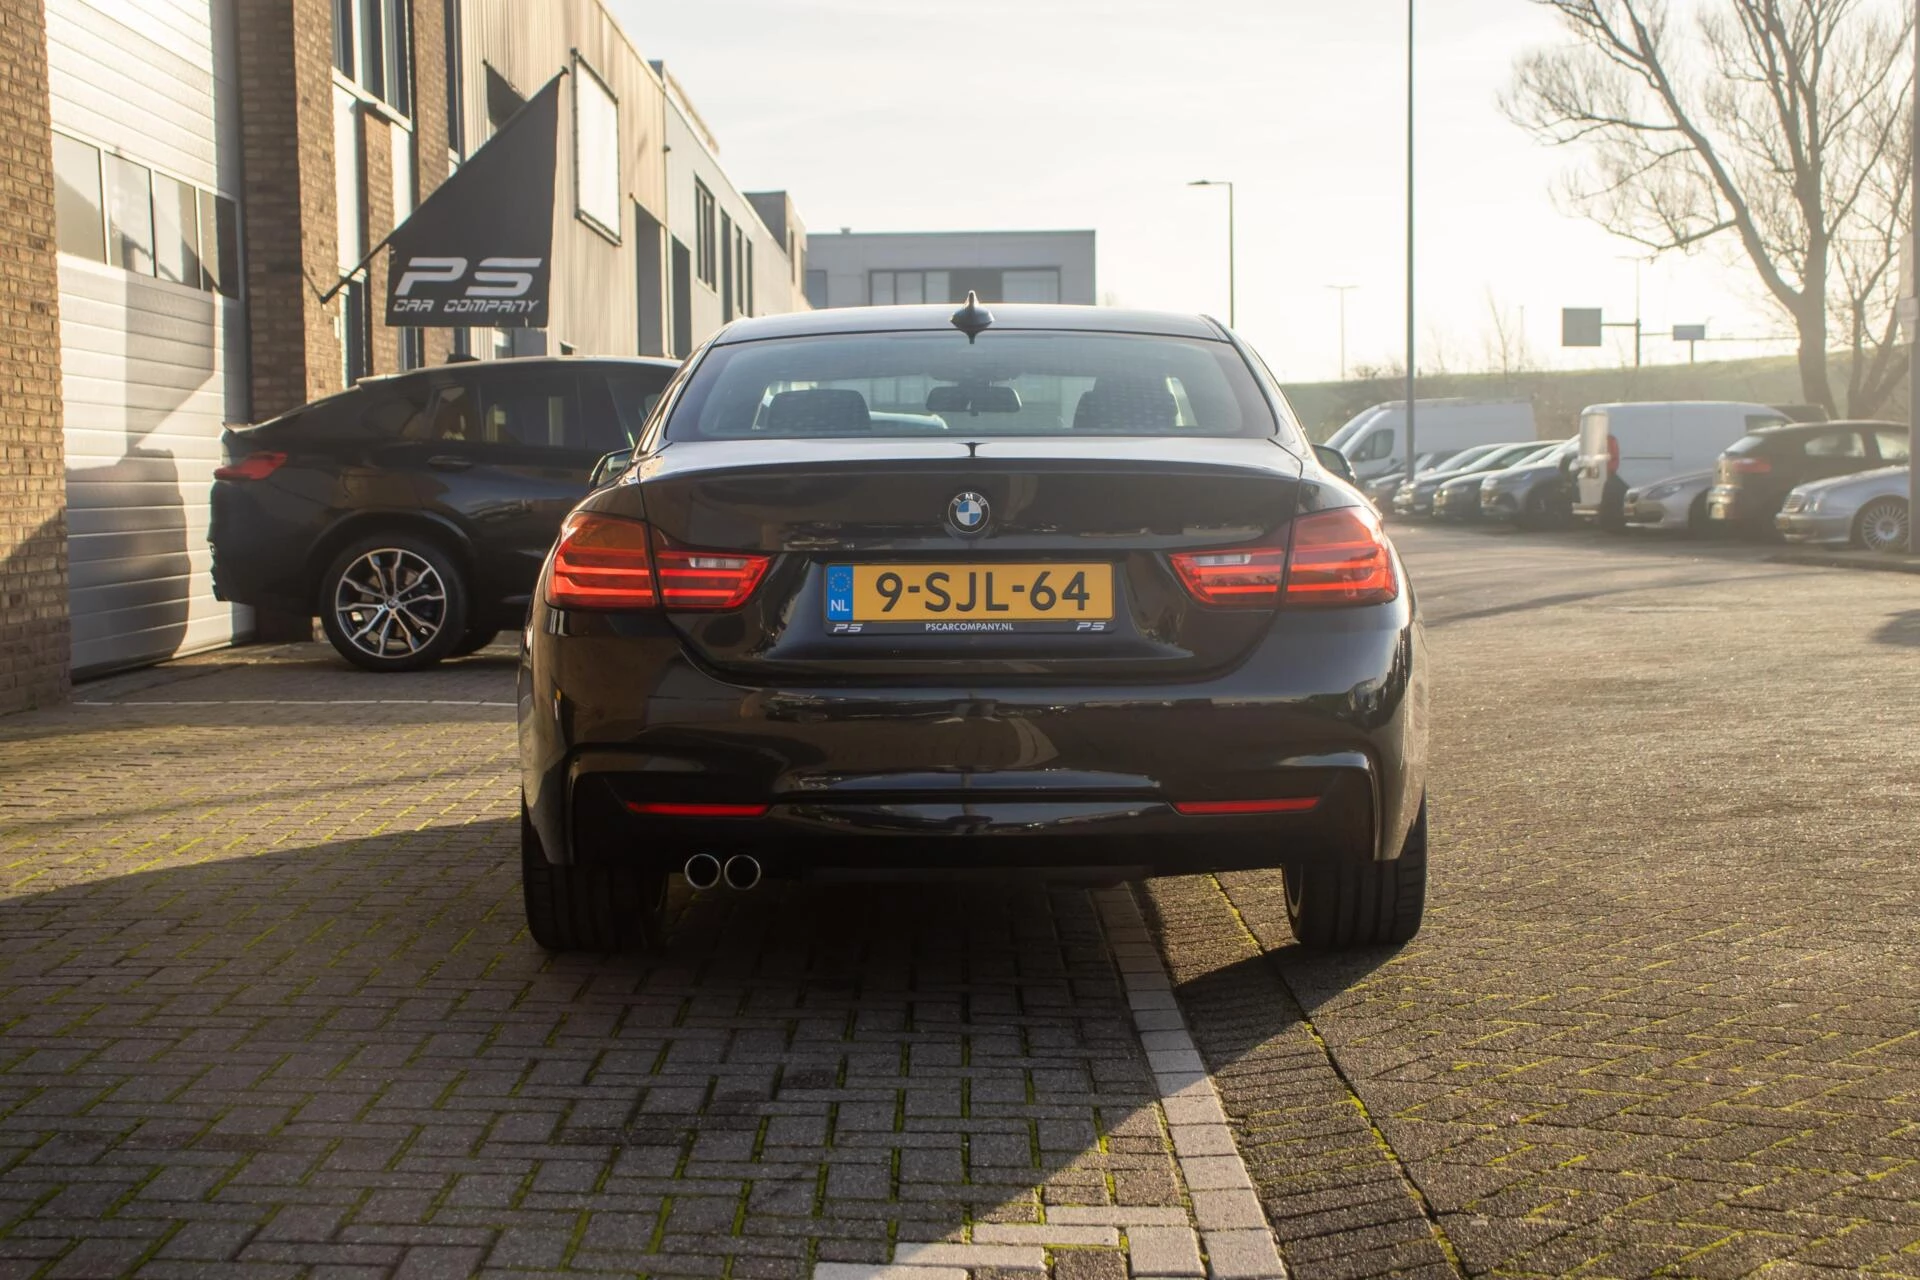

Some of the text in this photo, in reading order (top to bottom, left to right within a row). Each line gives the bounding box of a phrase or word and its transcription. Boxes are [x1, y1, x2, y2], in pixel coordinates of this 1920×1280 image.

[395, 257, 543, 297] PS
[393, 299, 540, 313] CAR COMPANY
[876, 571, 1090, 612] 9-SJL-64
[831, 599, 850, 612] NL
[833, 623, 864, 633] PS
[925, 623, 1014, 631] PSCARCOMPANY.NL
[1076, 622, 1106, 631] PS
